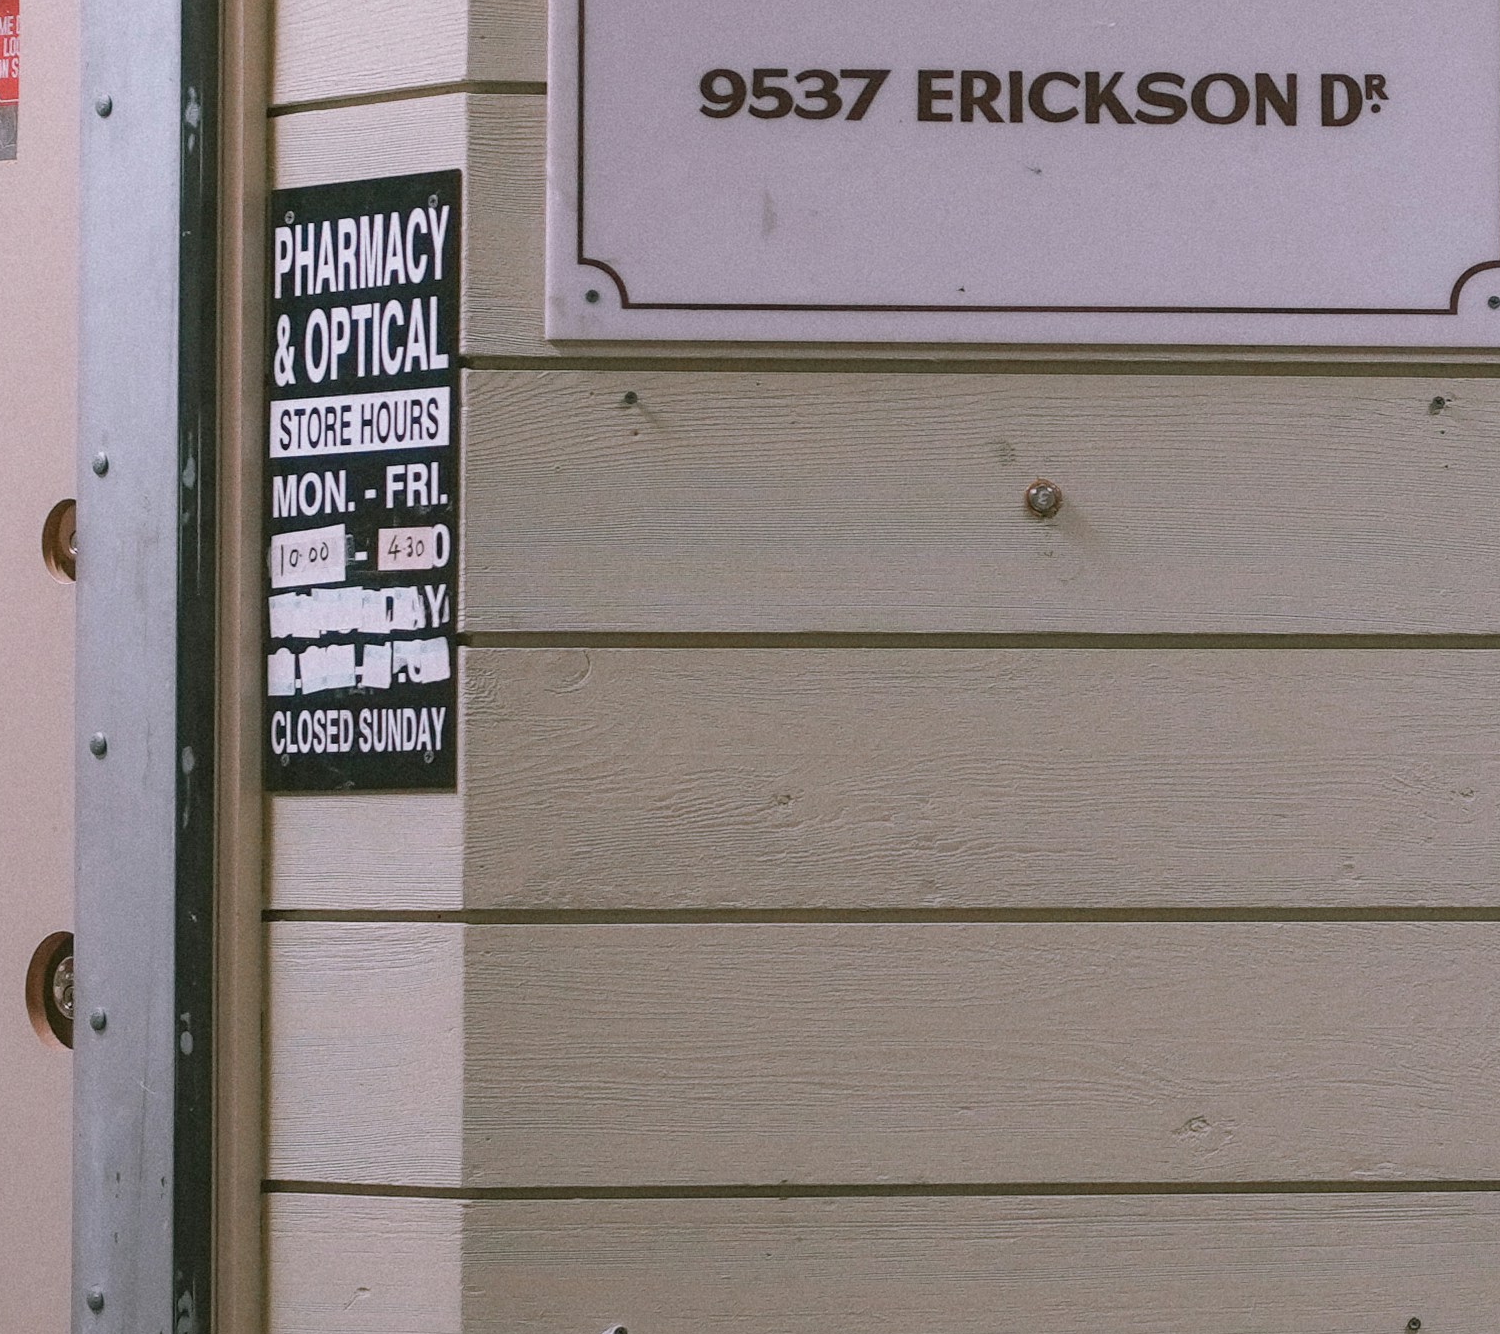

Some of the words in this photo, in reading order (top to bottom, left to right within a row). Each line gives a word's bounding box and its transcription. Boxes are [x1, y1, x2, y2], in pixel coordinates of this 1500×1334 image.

[700, 68, 891, 122] 9537
[916, 69, 1297, 127] ERICKSON
[274, 205, 450, 299] PHARMACY
[273, 314, 296, 387] &
[304, 295, 449, 383] OPTICAL
[279, 404, 352, 451] STORE
[360, 396, 439, 445] HOURS
[272, 469, 356, 518] MON.
[385, 461, 448, 509] FRI.
[271, 709, 354, 755] CLOSED
[358, 706, 447, 753] SUNDAY
